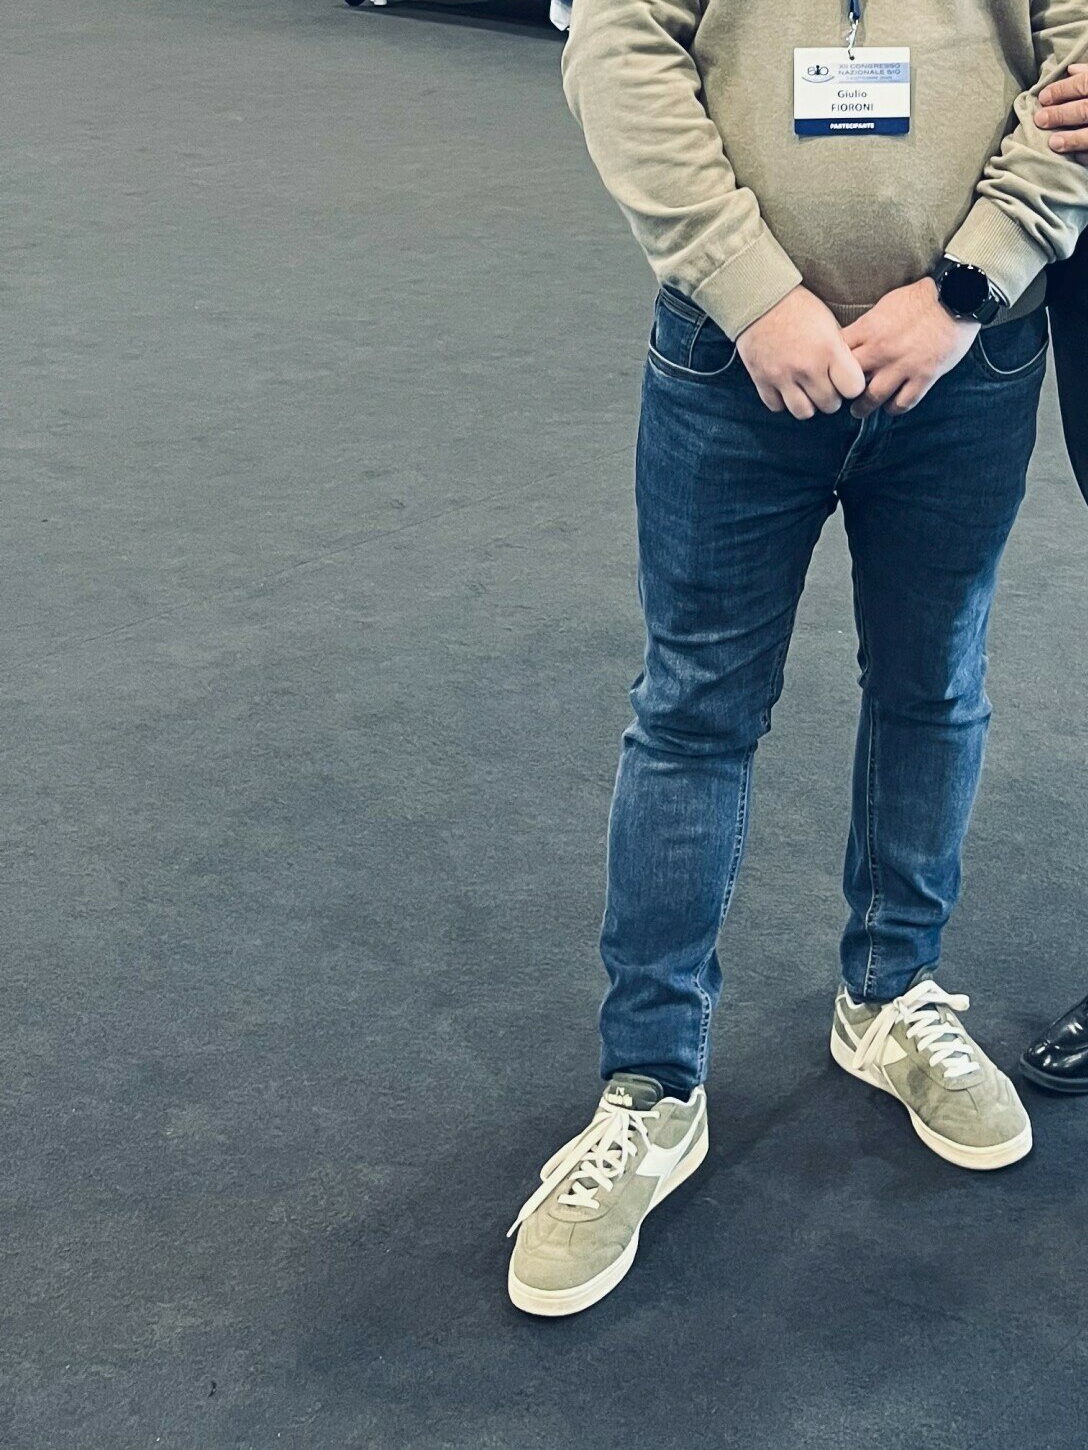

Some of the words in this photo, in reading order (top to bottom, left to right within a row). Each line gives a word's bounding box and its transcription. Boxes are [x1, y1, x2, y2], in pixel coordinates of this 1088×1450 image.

[837, 90, 868, 98] Giulio
[831, 103, 874, 112] FIORONI
[829, 122, 876, 130] PARTECIPANTE
